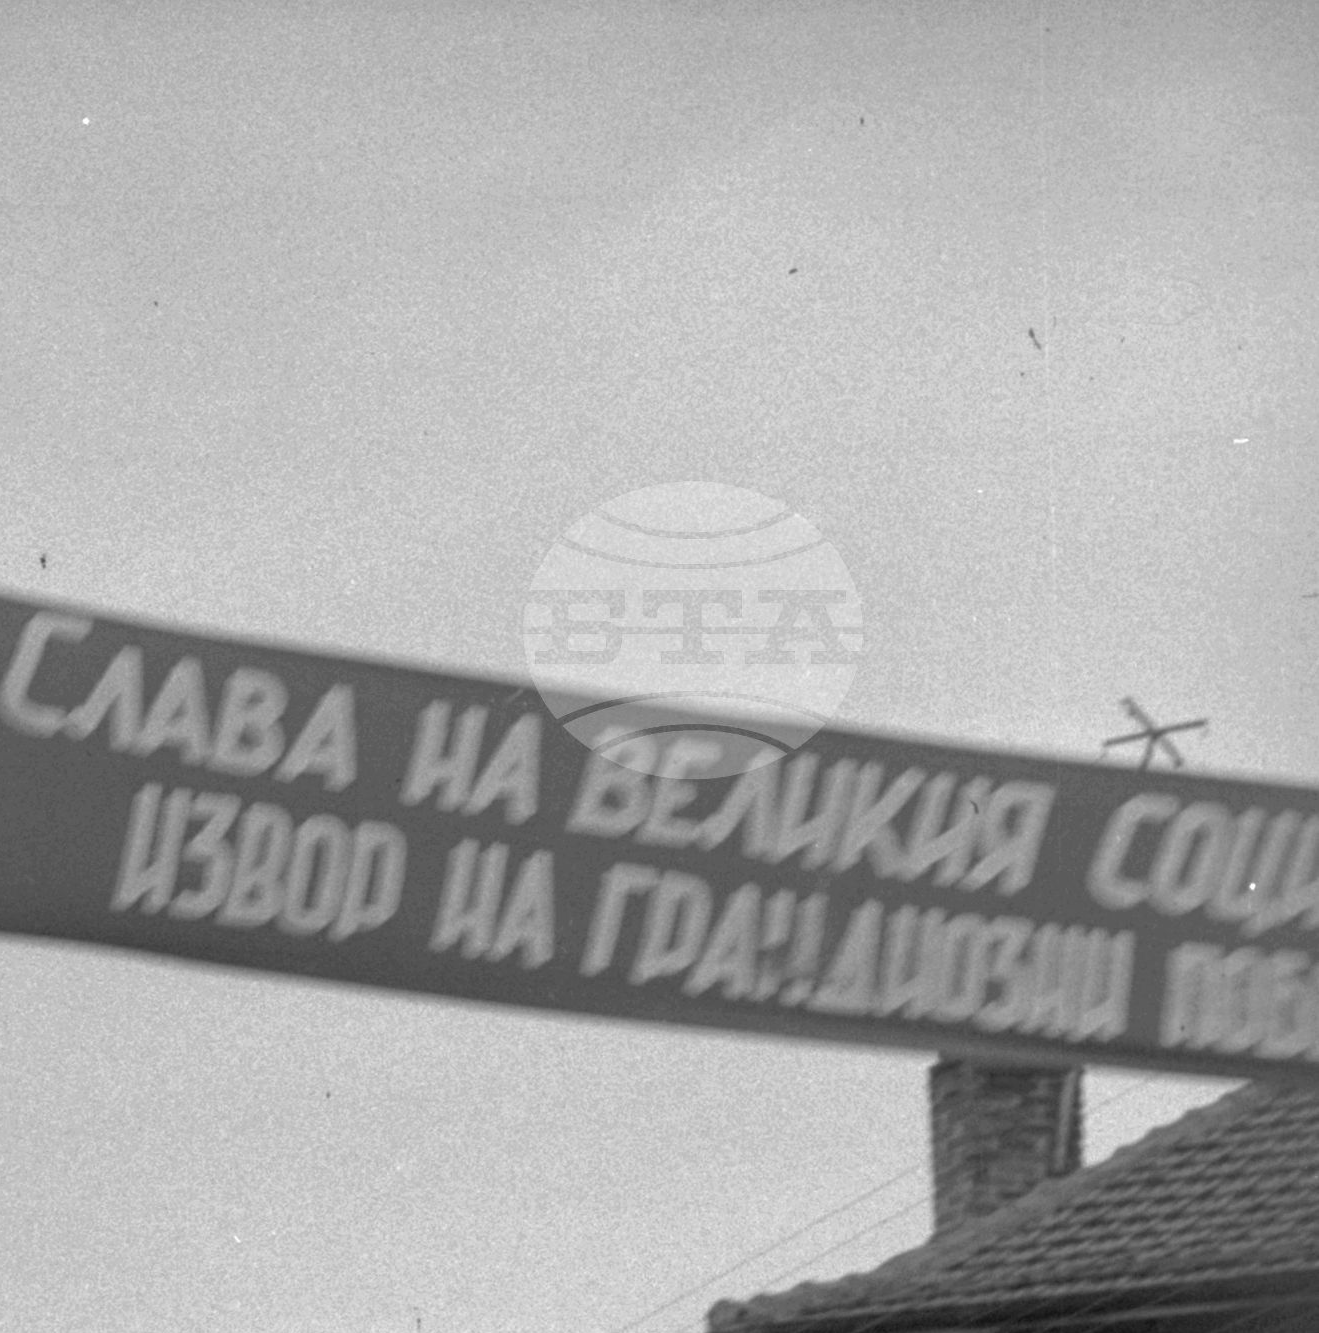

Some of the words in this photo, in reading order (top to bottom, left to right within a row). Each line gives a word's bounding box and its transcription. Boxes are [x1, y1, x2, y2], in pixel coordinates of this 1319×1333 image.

[402, 698, 543, 826] НА
[566, 726, 1055, 896] ВЕЛИКИЯ
[110, 782, 408, 943] ИЗВОР
[428, 837, 556, 970] НА
[1160, 940, 1319, 1062] ПОБ
